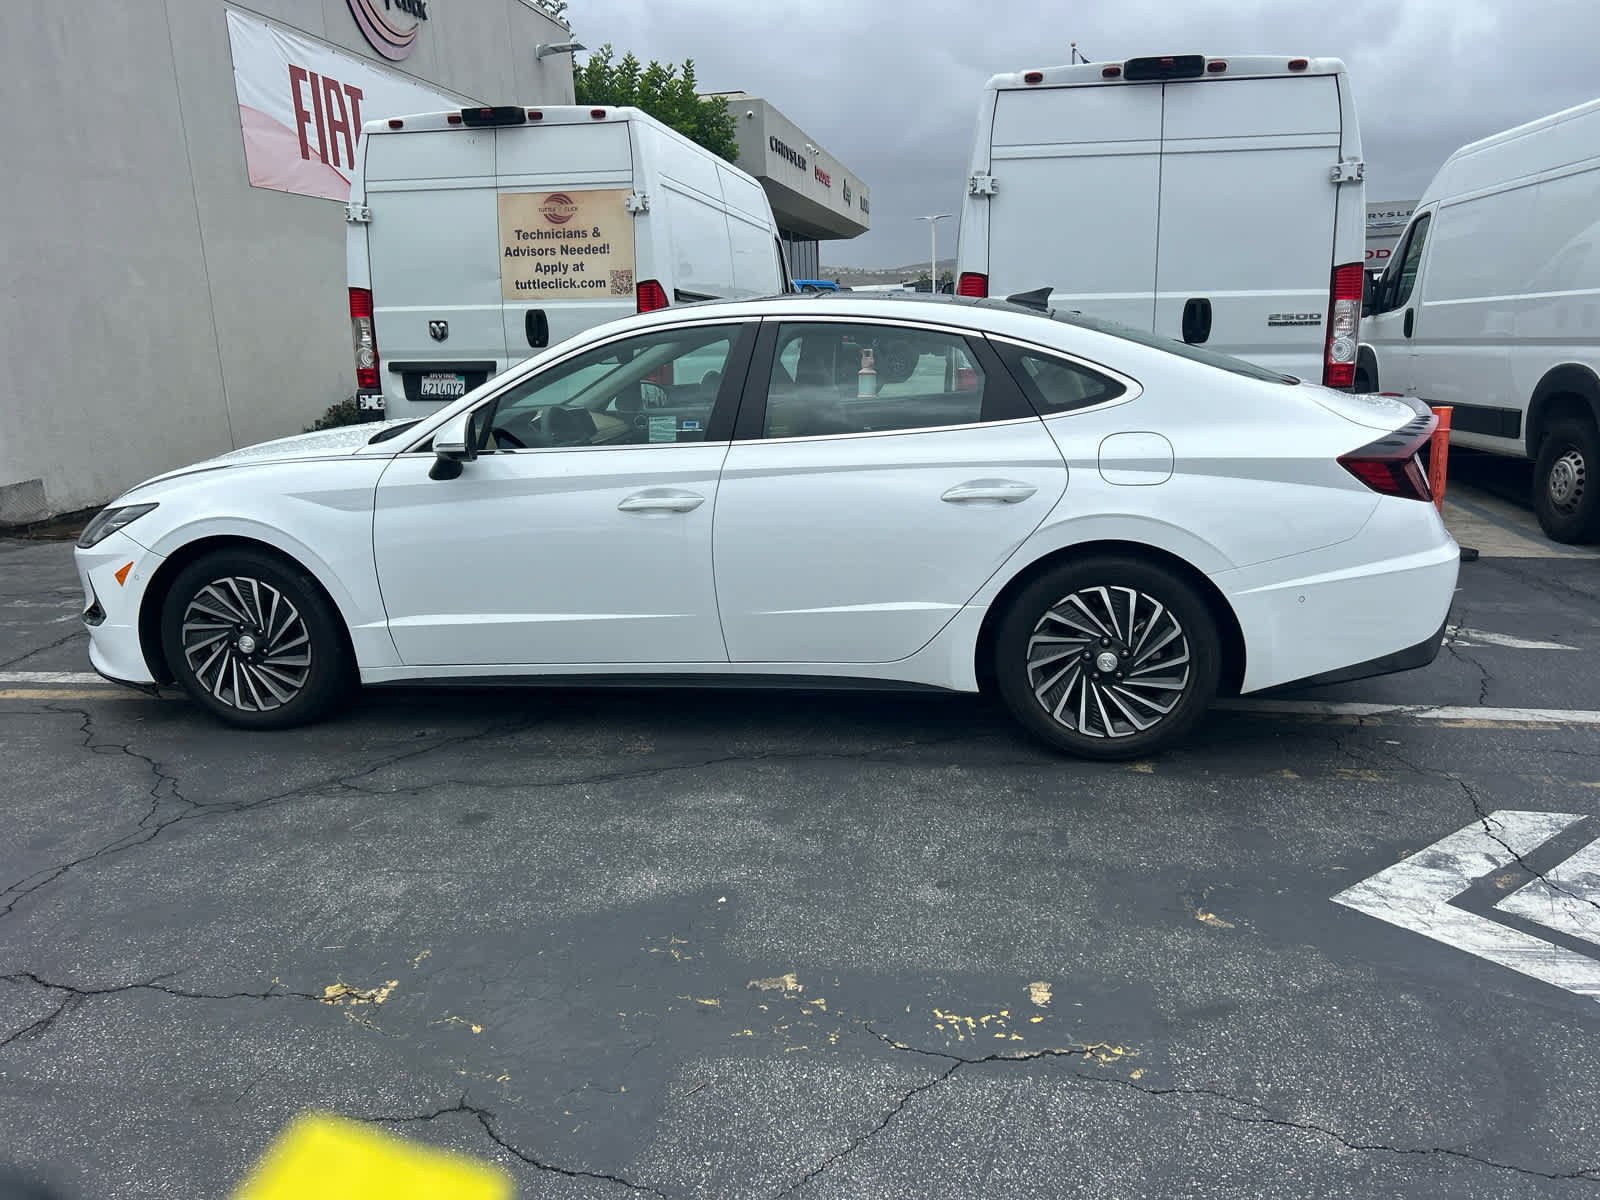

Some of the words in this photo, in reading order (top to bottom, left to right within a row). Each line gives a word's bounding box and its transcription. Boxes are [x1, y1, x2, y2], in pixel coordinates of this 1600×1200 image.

[288, 63, 363, 171] FIAT
[514, 228, 587, 240] Technicians
[592, 226, 601, 238] &
[504, 246, 556, 257] Advisors
[560, 243, 610, 256] Needed!
[534, 262, 569, 275] Apply
[572, 261, 585, 272] at
[514, 278, 607, 290] tuttleclick.com
[1268, 313, 1322, 321] 2500
